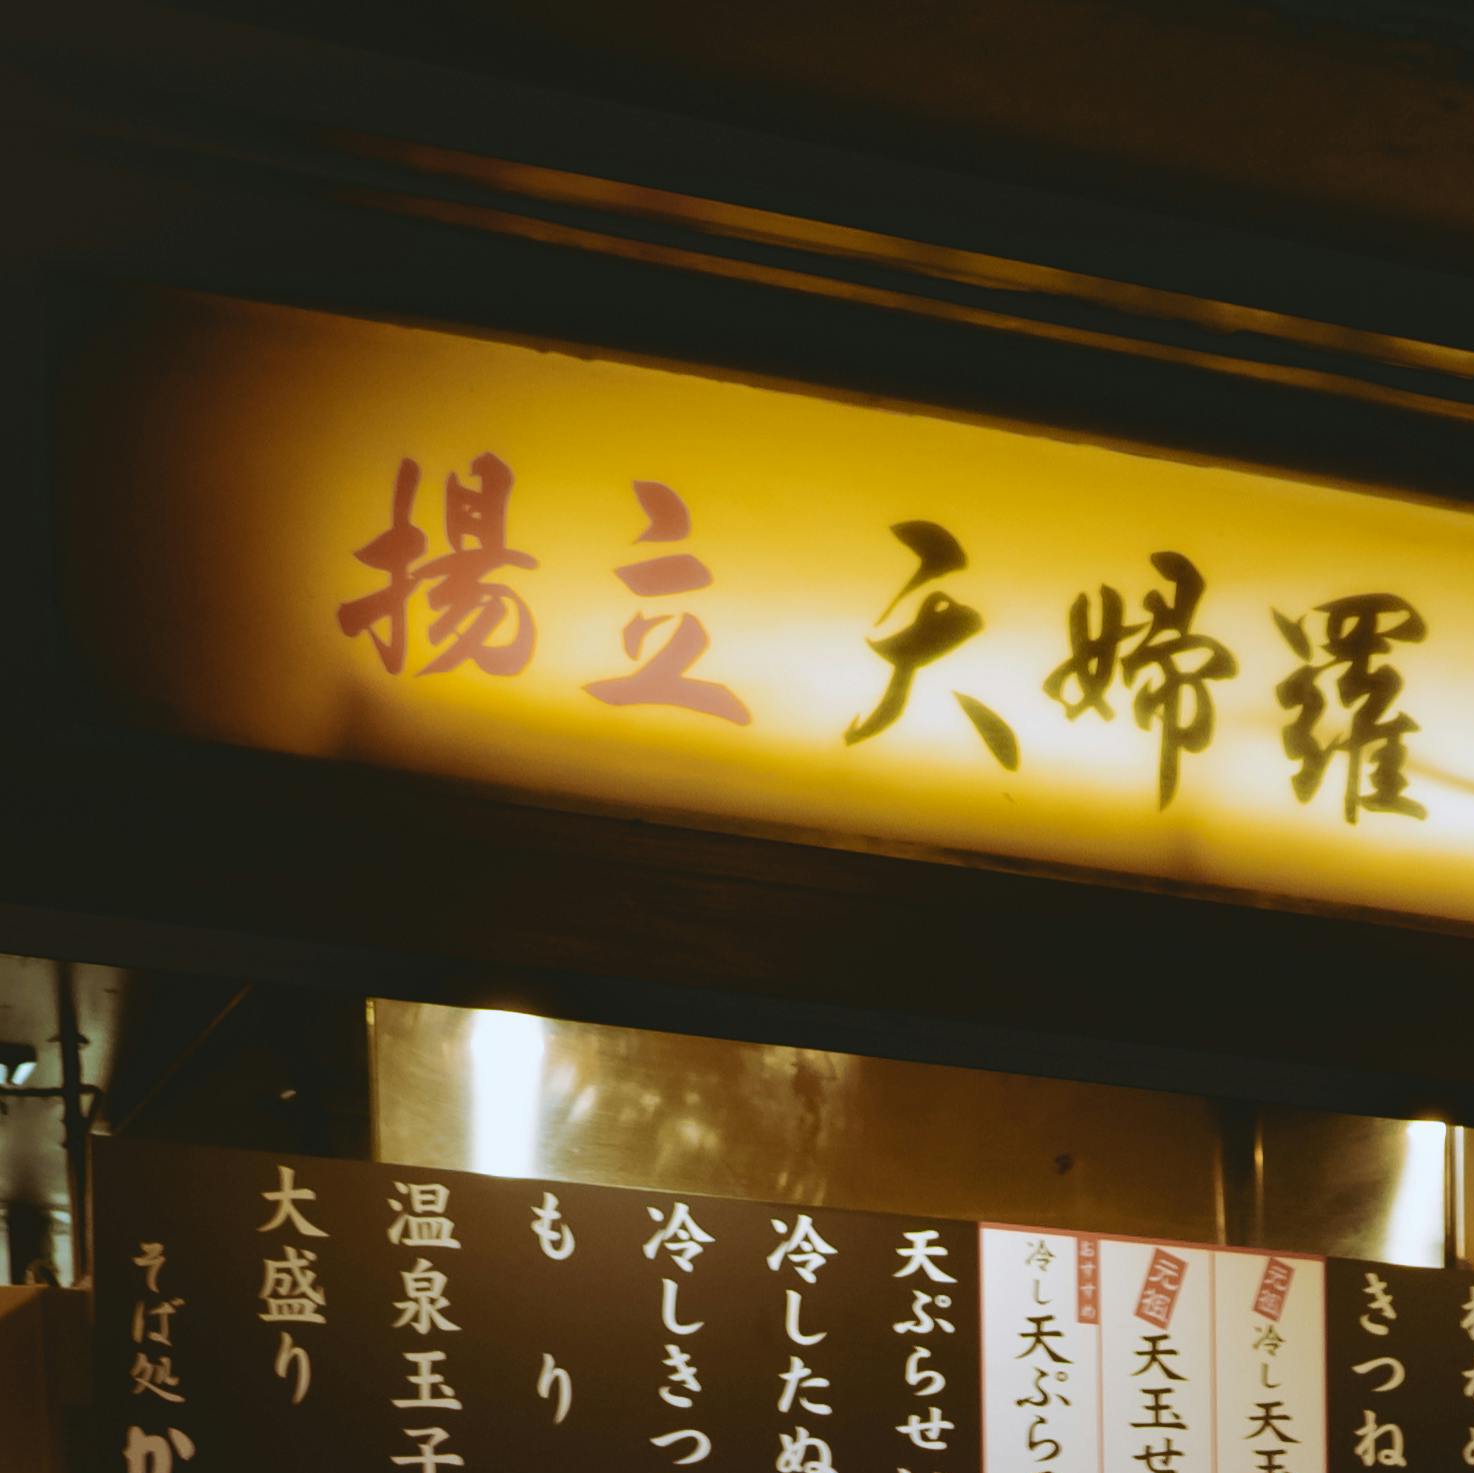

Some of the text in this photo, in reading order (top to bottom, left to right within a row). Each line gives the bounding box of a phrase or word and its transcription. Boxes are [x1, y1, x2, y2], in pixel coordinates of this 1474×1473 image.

[335, 451, 753, 727] 揚立
[843, 520, 1429, 827] 天婦羅
[132, 1242, 185, 1403] そば処
[257, 1165, 329, 1405] 大盛り
[531, 1193, 575, 1425] もり
[1352, 1272, 1408, 1469] きつね
